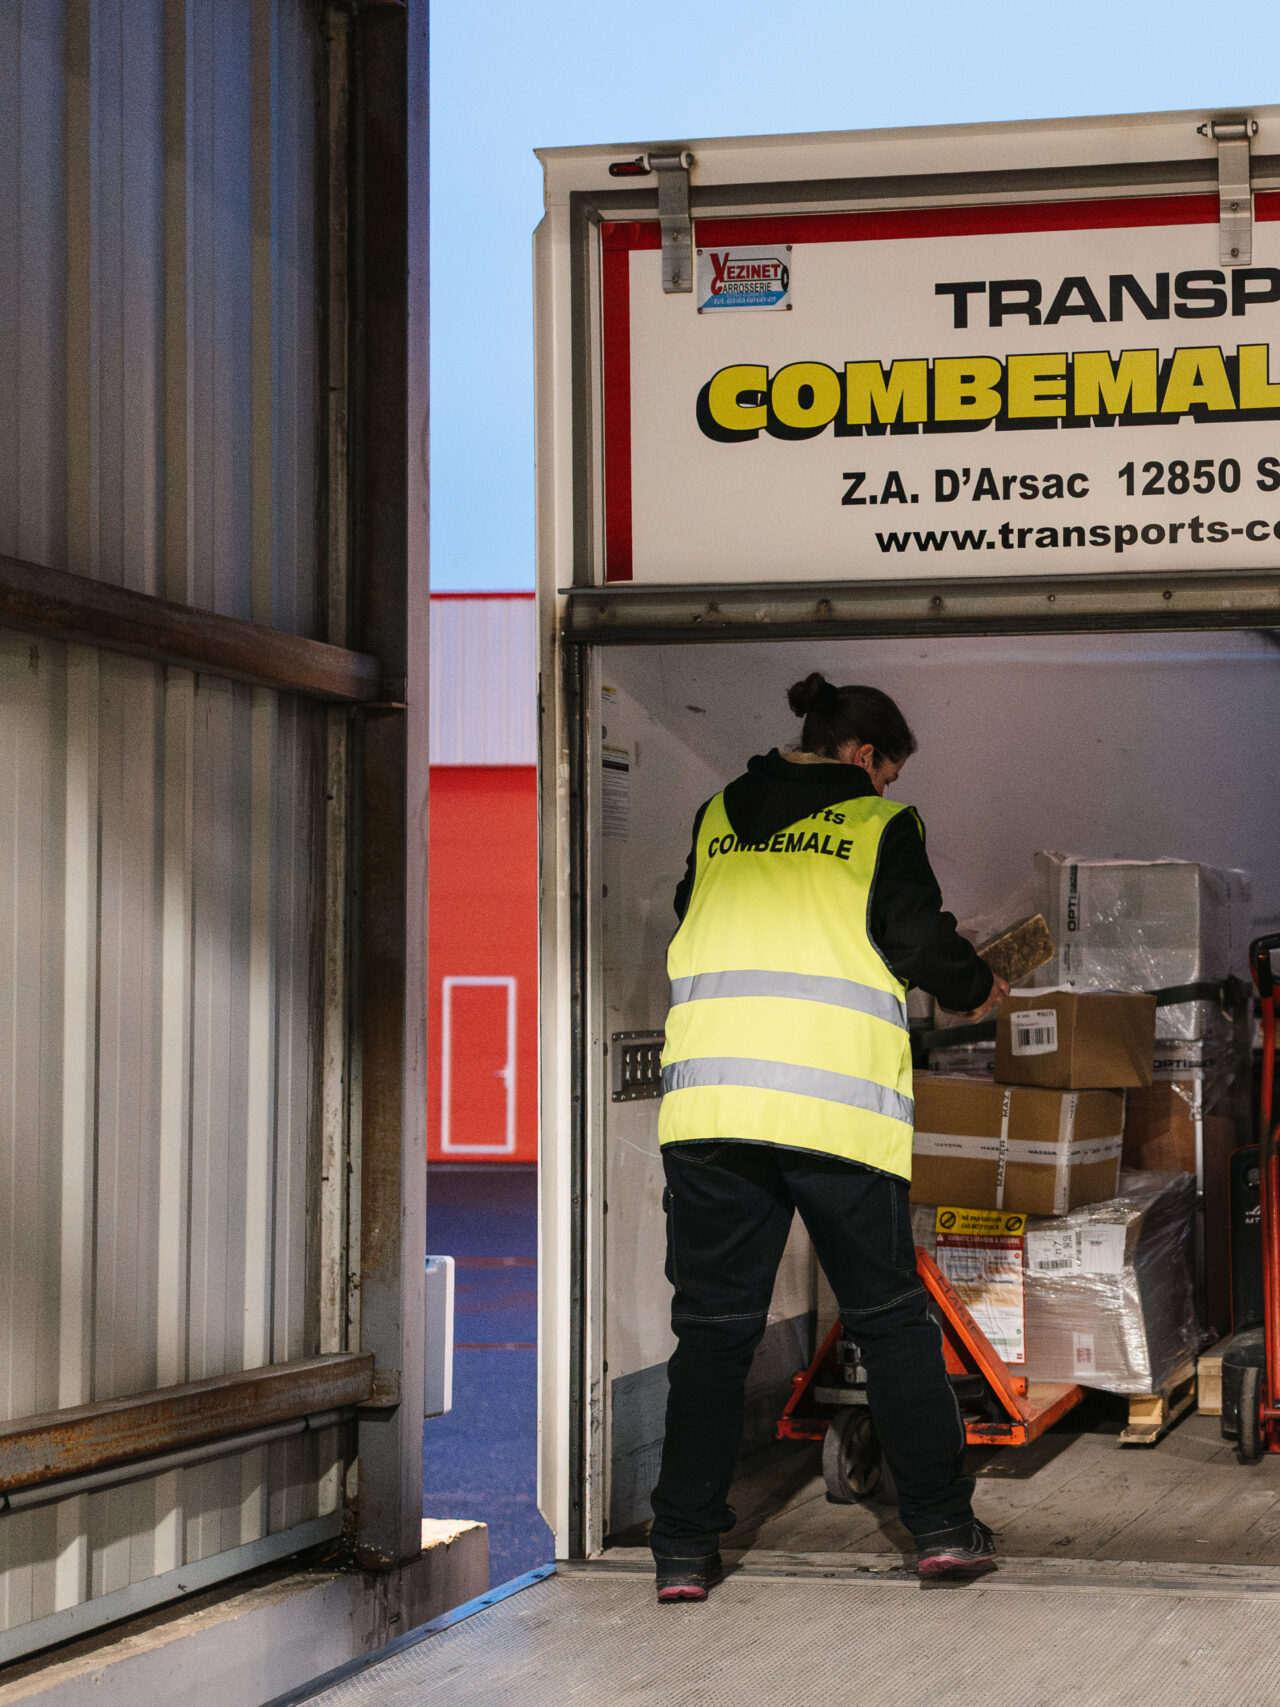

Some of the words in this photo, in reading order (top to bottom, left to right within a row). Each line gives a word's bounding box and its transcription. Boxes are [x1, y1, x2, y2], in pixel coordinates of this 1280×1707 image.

[710, 252, 781, 283] VEZINET
[711, 277, 772, 295] CARROSSERIE
[842, 471, 919, 506] Z.A.
[935, 467, 1090, 503] D'Arsac
[1118, 458, 1241, 496] 12850
